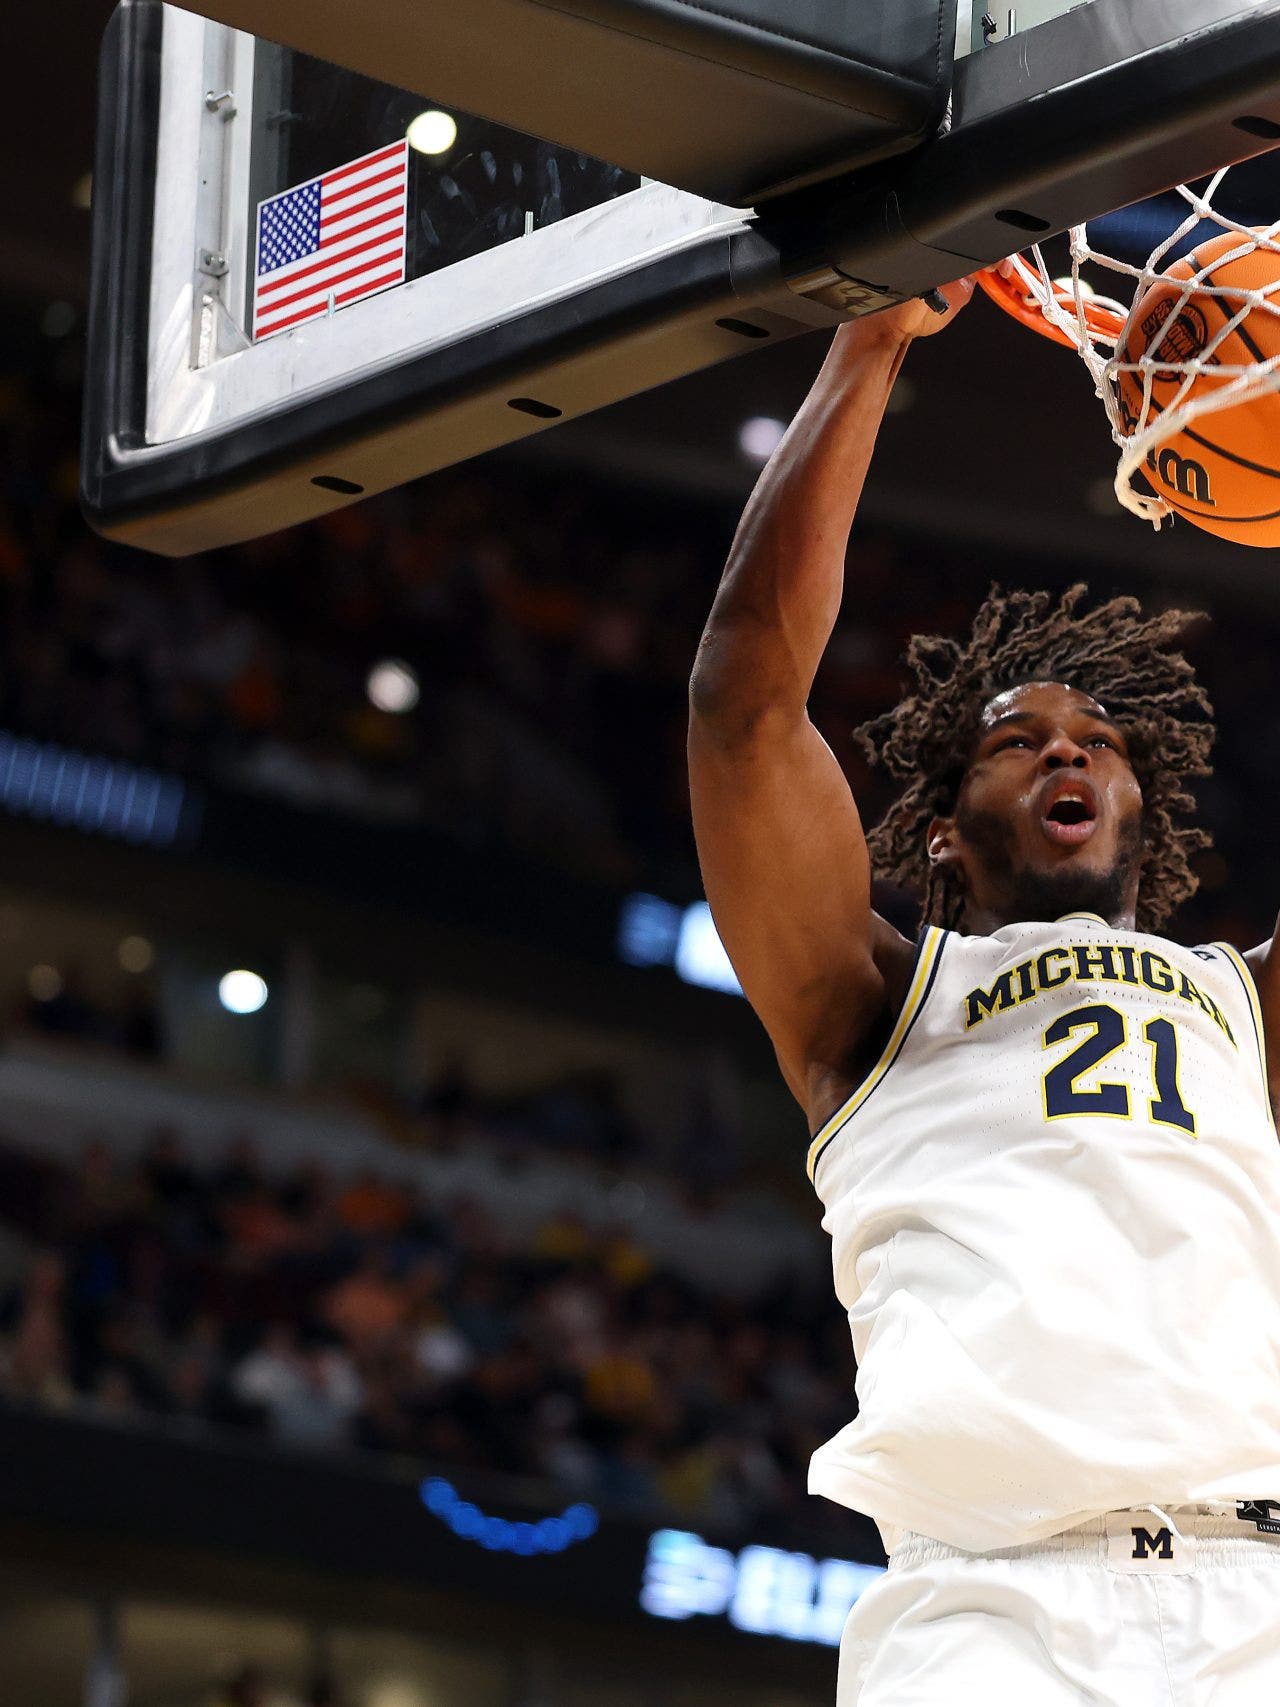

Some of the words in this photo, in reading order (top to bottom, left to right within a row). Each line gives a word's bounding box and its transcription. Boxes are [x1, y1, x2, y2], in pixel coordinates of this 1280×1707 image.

[963, 944, 1239, 1051] MICHIGAN
[1040, 1001, 1198, 1139] 21
[1131, 1527, 1174, 1559] M
